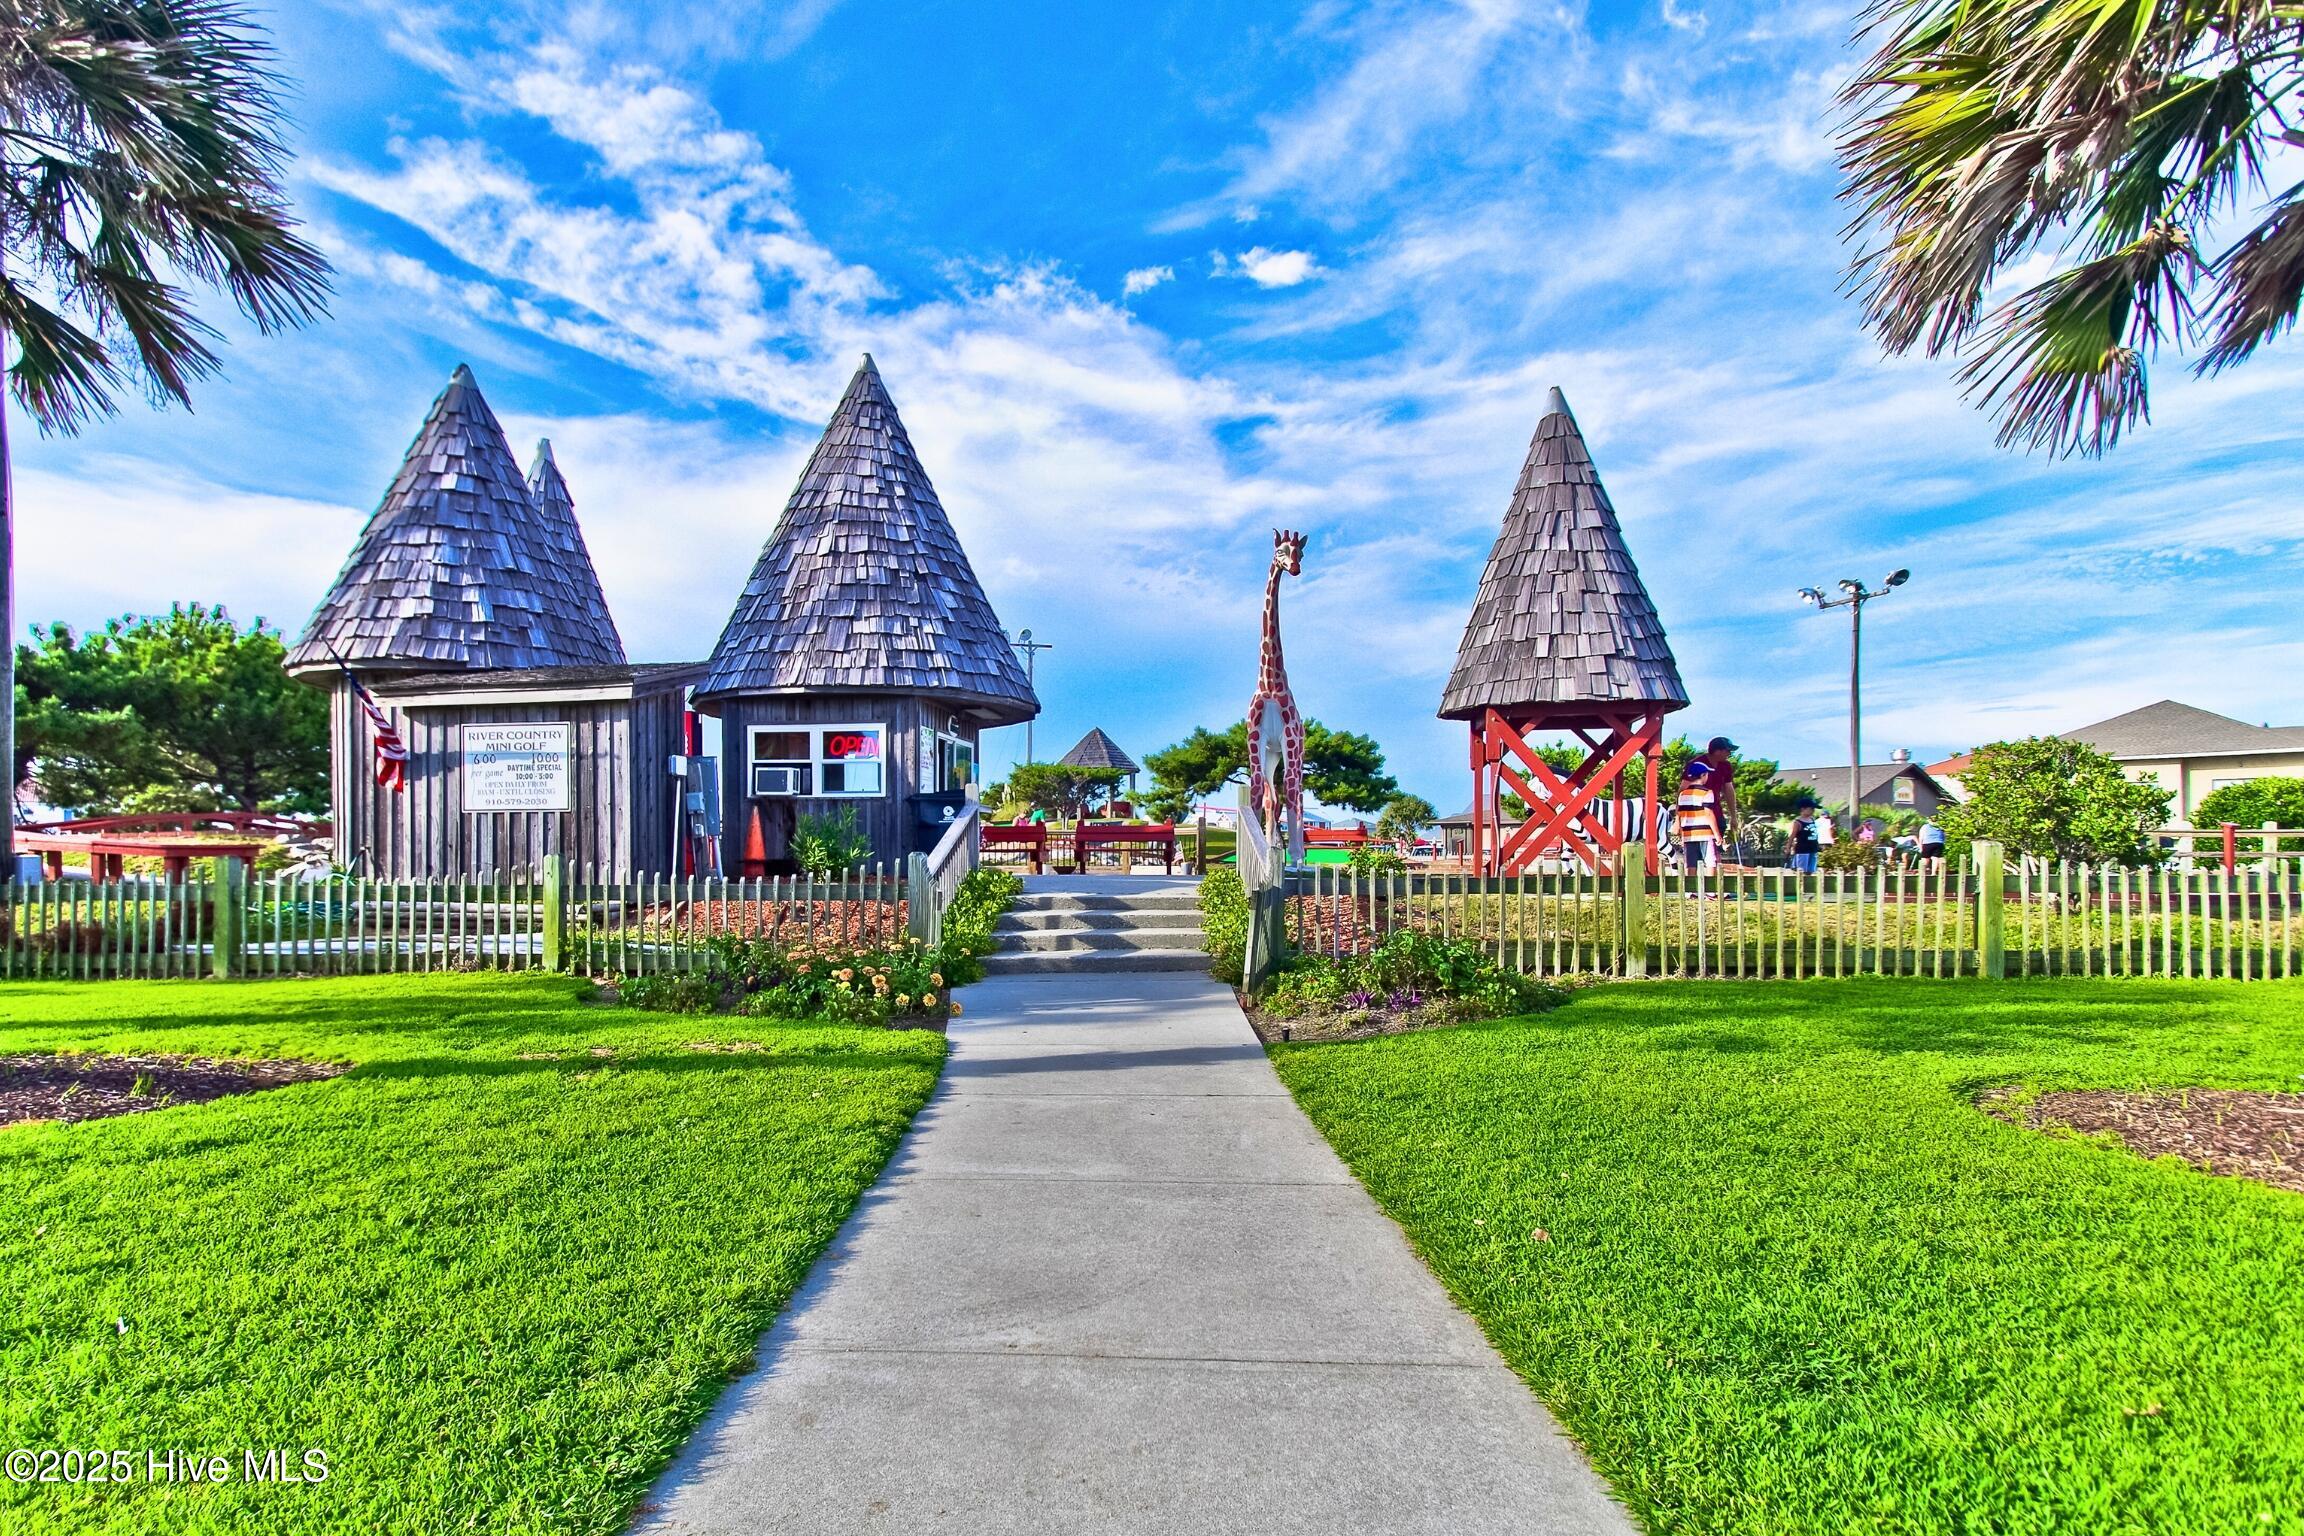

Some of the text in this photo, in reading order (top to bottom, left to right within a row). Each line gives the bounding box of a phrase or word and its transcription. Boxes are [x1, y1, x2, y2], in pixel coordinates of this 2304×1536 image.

[468, 730, 563, 741] RIVER COUNTRY
[485, 741, 547, 752] MINI GOLF
[507, 764, 535, 772] DAYTIME
[485, 770, 504, 778] game
